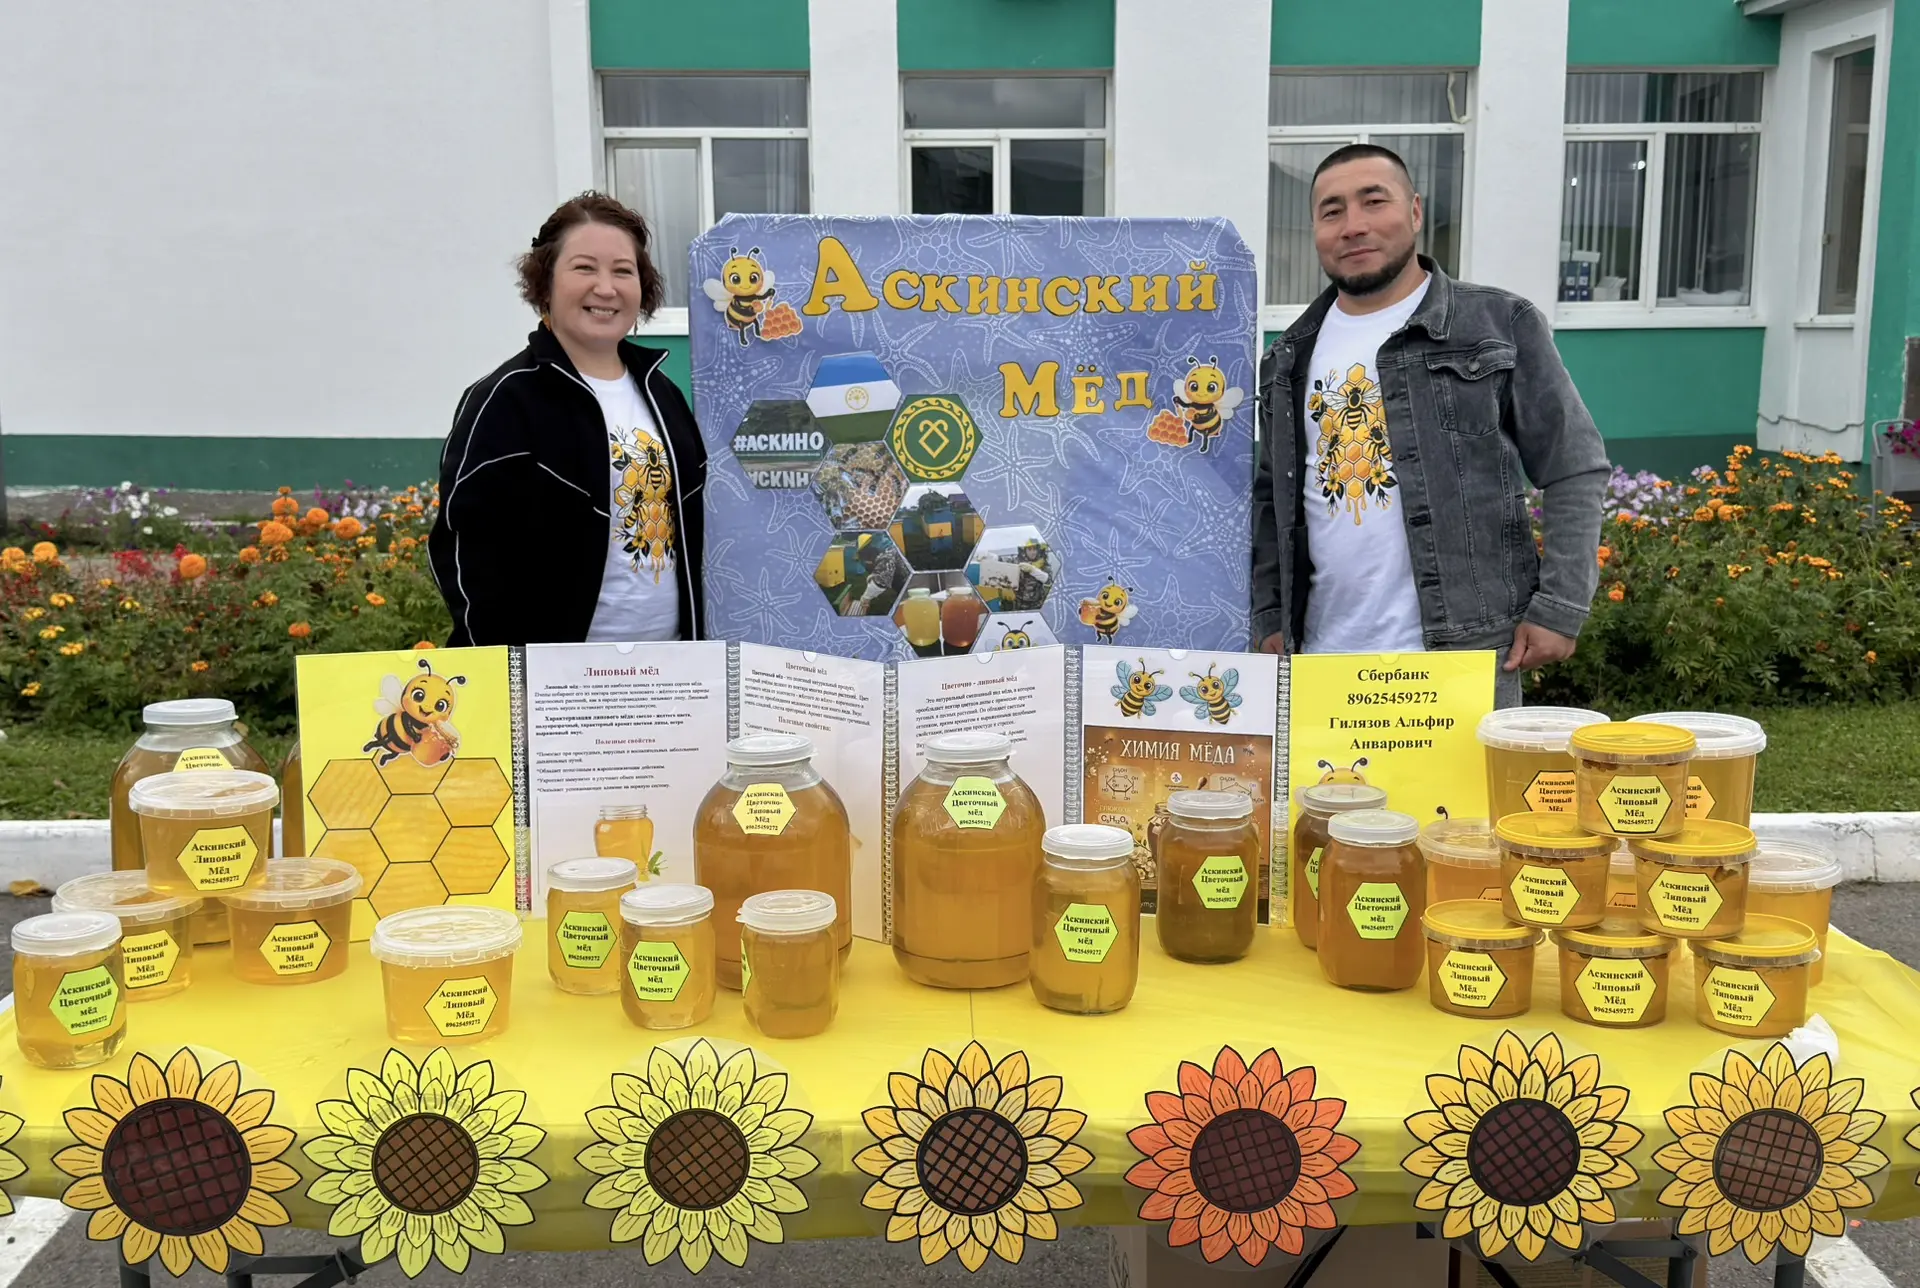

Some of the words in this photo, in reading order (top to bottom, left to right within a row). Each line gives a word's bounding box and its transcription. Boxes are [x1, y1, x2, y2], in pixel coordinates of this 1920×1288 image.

[801, 235, 1218, 317] Аскинский
[998, 359, 1153, 418] Мёд
[733, 431, 824, 451] #АСКИНО
[583, 666, 637, 677] Липовый
[640, 666, 659, 676] мёд
[785, 662, 816, 674] Цветочный
[817, 667, 828, 676] мёд
[1357, 669, 1430, 684] Сбербанк
[941, 681, 972, 691] Цветочно
[977, 677, 1004, 686] липовый
[1006, 675, 1018, 683] мёд
[1347, 692, 1438, 705] 89625459272
[1329, 717, 1391, 730] Гилязов
[1395, 716, 1455, 730] Альфир
[1349, 739, 1433, 751] Анварович
[1120, 739, 1181, 761] ХИМИЯ
[1189, 741, 1235, 765] МЁДА
[181, 754, 220, 762] Аскинский
[1609, 785, 1661, 795] Аскинский
[1538, 796, 1572, 804] Липовый
[1614, 797, 1658, 806] Липовый
[1548, 804, 1564, 812] Мёд
[1625, 808, 1645, 818] Мёд
[191, 839, 247, 851] Аскинский
[194, 852, 242, 864] Липовый
[208, 866, 230, 876] Мёд
[1202, 867, 1243, 875] Аскинский
[1201, 875, 1243, 884] Цветочный
[1519, 873, 1567, 886] Аскинский
[1216, 886, 1230, 894] мёд
[1522, 885, 1564, 897] Липовый
[1659, 880, 1710, 892] Аскинский
[1354, 895, 1400, 903] Аскинский
[1534, 898, 1553, 908] Мёд
[1663, 892, 1707, 903] Липовый
[1354, 902, 1401, 912] Цветочный
[1672, 904, 1692, 914] Мёд
[1064, 914, 1110, 925] Аскинский
[563, 923, 608, 932] Аскинский
[1063, 923, 1110, 934] Цветочный
[271, 931, 319, 942] Аскинский
[563, 930, 609, 941] Цветочный
[1077, 937, 1093, 945] мёд
[273, 942, 314, 952] Липовый
[576, 944, 592, 952] мёд
[123, 951, 165, 964] Липовый
[633, 952, 679, 963] Аскинский
[136, 965, 155, 973] Мёд
[633, 962, 680, 972] Цветочный
[1446, 960, 1493, 971] Аскинский
[648, 975, 663, 984] мёд
[1450, 971, 1491, 982] Липовый
[1587, 969, 1644, 980] Аскинский
[59, 977, 111, 996] Аскинский
[1459, 983, 1477, 993] Мёд
[1592, 982, 1641, 992] Липовый
[1710, 977, 1760, 991] Аскинский
[439, 985, 488, 998] Аскинский
[1712, 988, 1754, 1002] Липовый
[59, 988, 112, 1008] Цветочный
[443, 997, 485, 1009] Липовый
[1604, 995, 1626, 1005] Мёд
[80, 1006, 98, 1016] мёд
[1593, 1006, 1634, 1014] 89625459272
[1723, 1002, 1742, 1013] Мёд
[456, 1011, 475, 1020] Мёд
